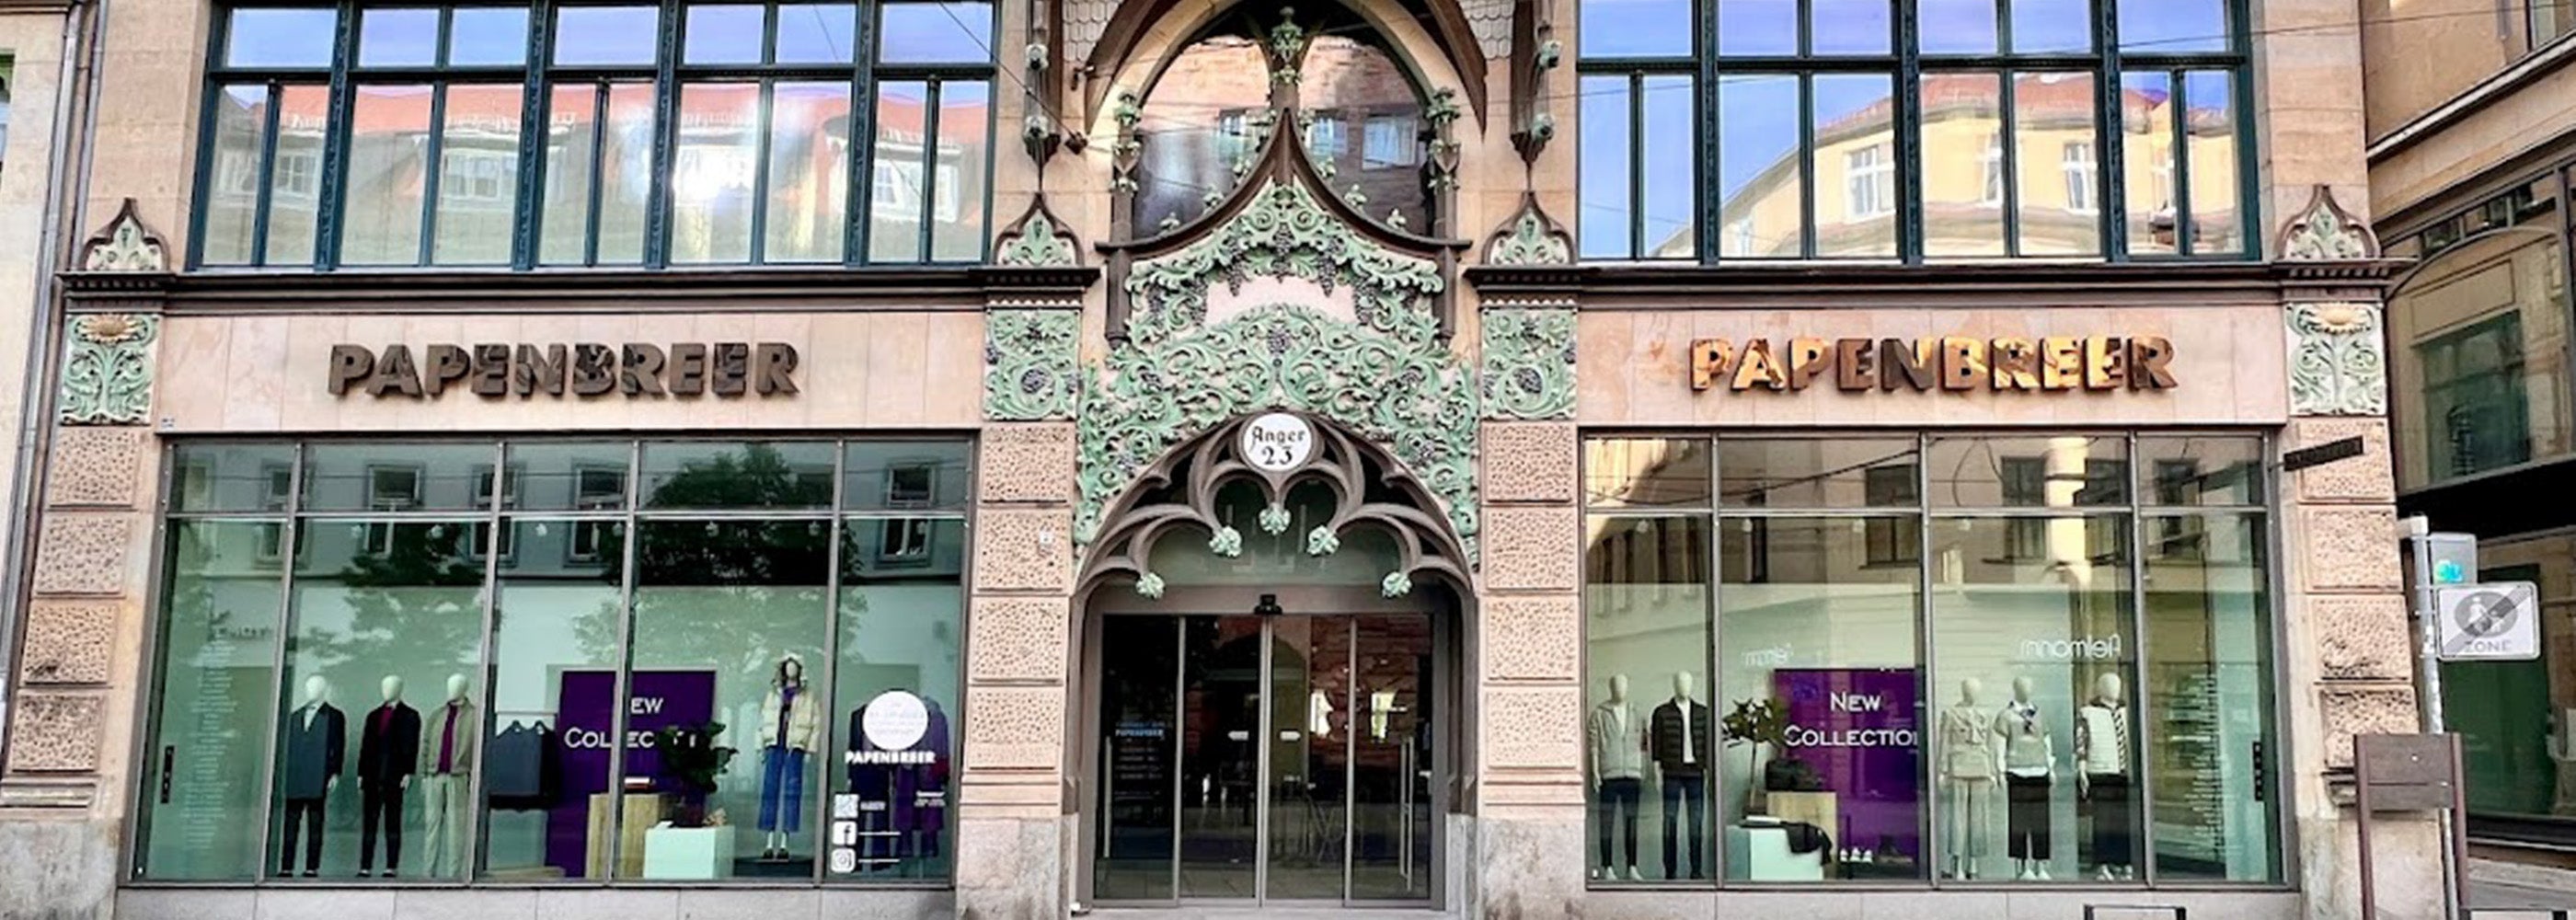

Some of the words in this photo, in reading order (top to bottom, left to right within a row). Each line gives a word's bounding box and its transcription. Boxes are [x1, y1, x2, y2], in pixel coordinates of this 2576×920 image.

[328, 343, 800, 398] PAPENBREER
[1689, 336, 2178, 393] PAPENBREER
[1249, 425, 1305, 453] Anger
[1261, 445, 1293, 466] 23
[2465, 640, 2512, 652] ZONE
[630, 696, 664, 715] EW
